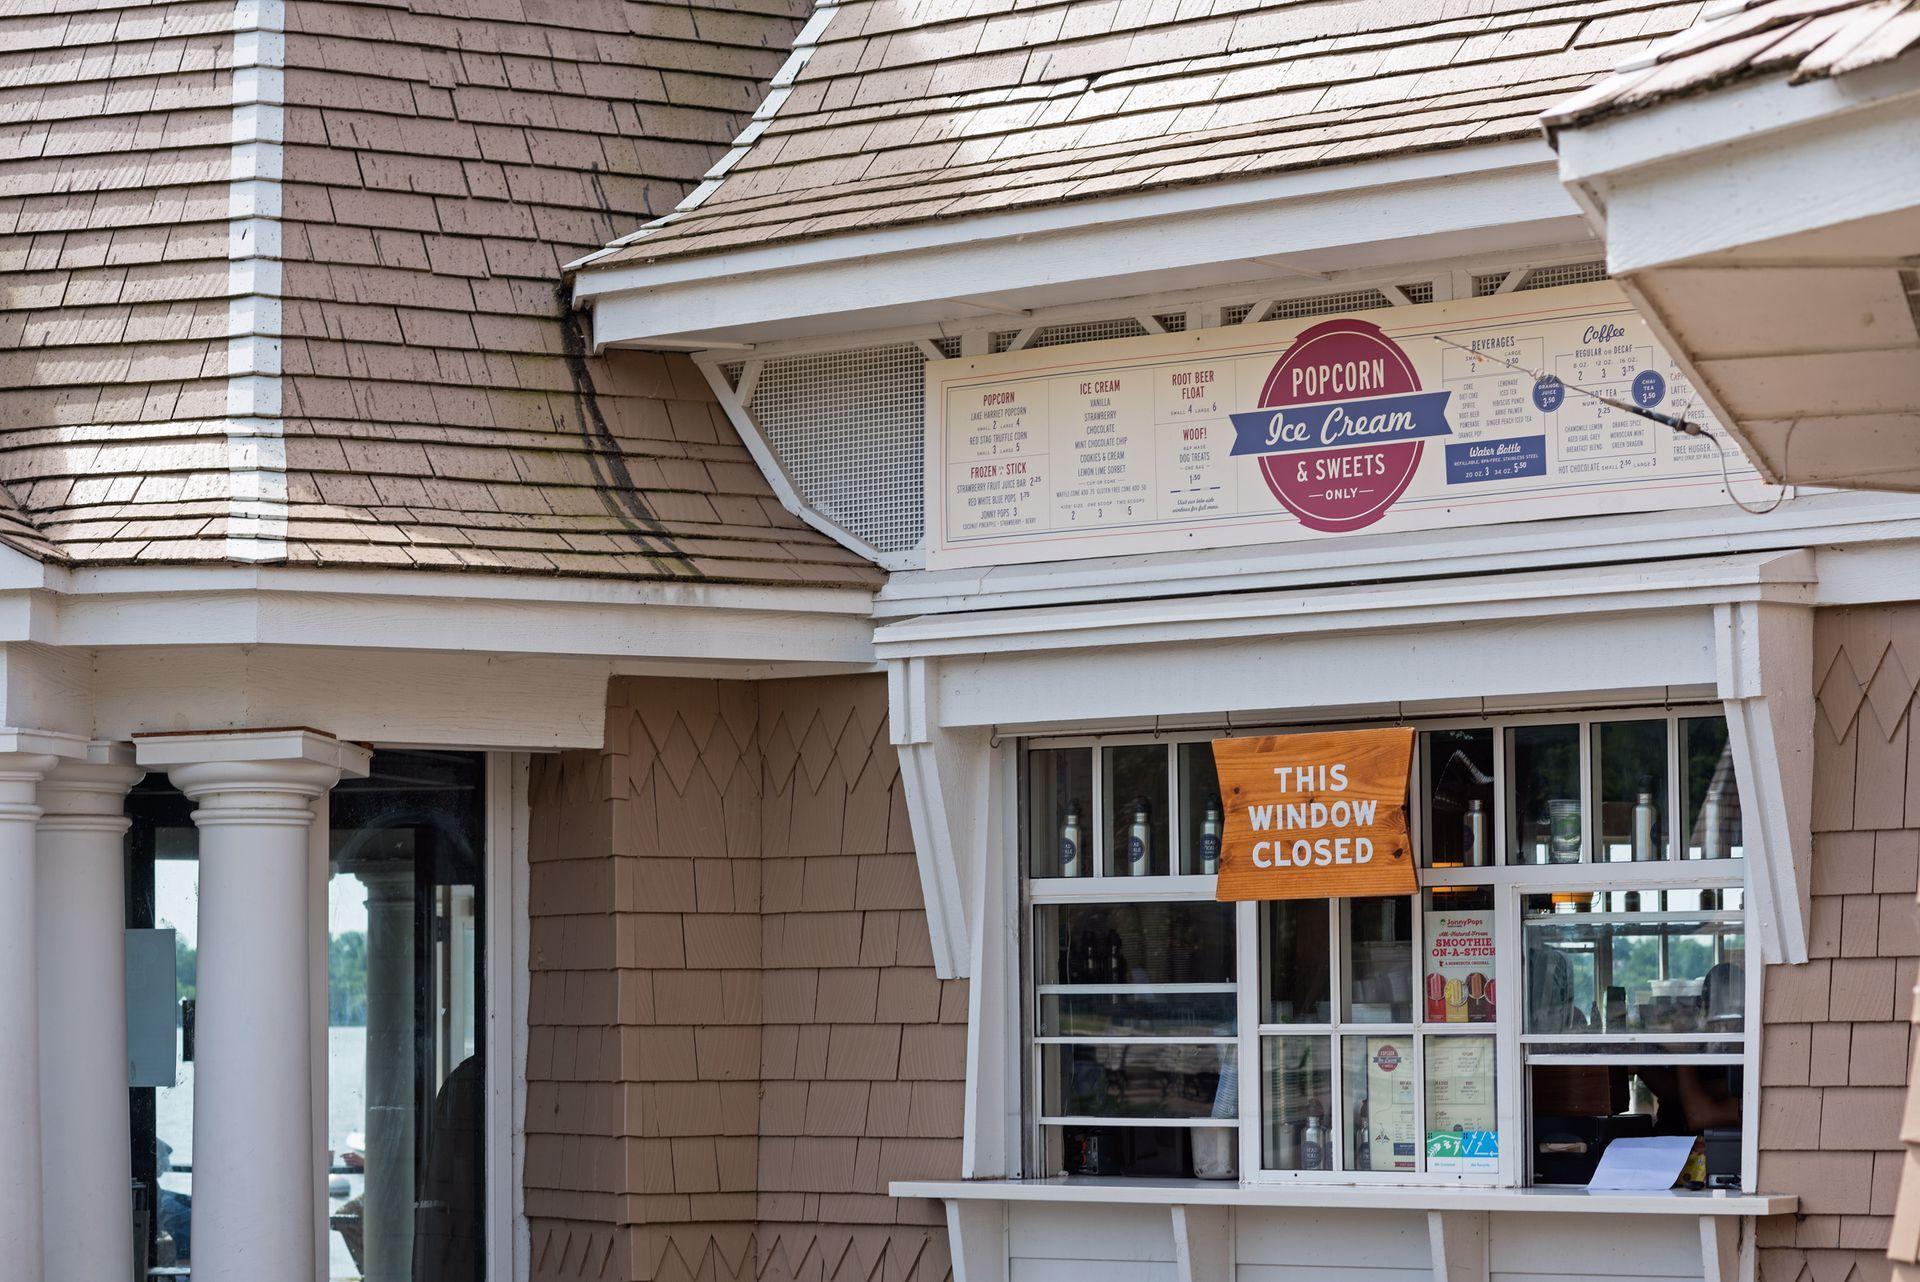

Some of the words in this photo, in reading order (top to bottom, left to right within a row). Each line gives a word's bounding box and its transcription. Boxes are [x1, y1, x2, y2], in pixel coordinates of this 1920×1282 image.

[1583, 324, 1625, 344] Coffee
[1472, 336, 1515, 351] BEVERAGES
[1575, 347, 1602, 358] REGULAR
[1613, 344, 1633, 354] DECAF
[1471, 363, 1476, 373] 2
[1578, 371, 1583, 381] 2
[1602, 368, 1606, 378] 3
[1171, 372, 1192, 386] ROOT
[1194, 370, 1215, 385] BEER
[1292, 358, 1385, 398] POPCORN
[1080, 382, 1092, 395] ICE
[1094, 380, 1121, 393] CREAM
[1181, 386, 1205, 400] FLOAT
[1605, 388, 1617, 397] TEA
[1670, 385, 1687, 395] LATTE
[983, 391, 1015, 406] POPCORN
[1090, 398, 1111, 407] VANILLA
[1542, 397, 1556, 408] 3.50
[1642, 392, 1656, 404] 3.50
[971, 411, 982, 421] LAKE
[1004, 406, 1027, 417] POPCORN
[1188, 404, 1193, 414] 4
[1212, 402, 1217, 412] 6
[1597, 407, 1611, 418] 2.25
[1084, 411, 1117, 422] STRAWBERRY
[1687, 410, 1705, 420] PRESS
[993, 420, 997, 430] 2
[1016, 418, 1020, 427] 4
[1086, 424, 1115, 435] CHOCOLATE
[1265, 412, 1310, 446] Ice
[1320, 406, 1416, 445] Cream
[1564, 424, 1588, 433] CHAMOMILE
[1588, 423, 1603, 431] LEMON
[1014, 431, 1028, 441] CORN
[1182, 427, 1207, 441] WOOF!
[1610, 430, 1633, 439] MOROCCAN
[1634, 429, 1645, 437] MINT
[993, 445, 997, 455] 3
[1016, 442, 1020, 452] 5
[1074, 439, 1087, 449] MINT
[1087, 437, 1116, 449] CHOCOLATE
[1116, 436, 1128, 446] CHIP
[1612, 441, 1626, 449] GREEN
[1673, 446, 1687, 455] TREE
[1688, 443, 1711, 453] HUGGER
[1080, 452, 1101, 463] COOKIES
[1102, 452, 1106, 462] &
[1107, 451, 1125, 461] CREAM
[1469, 446, 1495, 458] Water
[1496, 443, 1522, 456] Bottle
[1179, 454, 1190, 464] DOG
[1191, 452, 1210, 461] TREATS
[971, 465, 997, 479] FROZEN
[1006, 462, 1027, 475] STICK
[1078, 466, 1094, 478] LEMON
[1095, 466, 1106, 476] LIME
[1107, 464, 1126, 475] SORBET
[1297, 461, 1308, 482] &
[1315, 453, 1386, 481] SWEETS
[1485, 466, 1490, 476] 3
[1513, 461, 1527, 473] 5.50
[1558, 465, 1569, 474] HOT
[1569, 462, 1600, 474] CHOCOLATE
[1620, 459, 1632, 469] 2.50
[1653, 457, 1657, 467] 3
[956, 482, 986, 494] STRAWBERRY
[1001, 480, 1015, 490] JUICE
[1016, 479, 1026, 488] BAR
[1004, 493, 1016, 503] POPS
[1325, 487, 1358, 500] ONLY
[981, 510, 996, 520] JONNY
[997, 508, 1010, 518] POPS
[1013, 507, 1017, 517] 3
[1071, 510, 1076, 520] 2
[1098, 508, 1103, 518] 3
[1128, 505, 1132, 516] 5
[1274, 763, 1349, 793] THIS
[1248, 800, 1377, 831] WINDOW
[1252, 837, 1374, 869] CLOSED
[1447, 918, 1483, 927] JonnyPops
[1435, 938, 1492, 947] SMOOTHIE
[1432, 947, 1496, 957] ON-A-STICK
